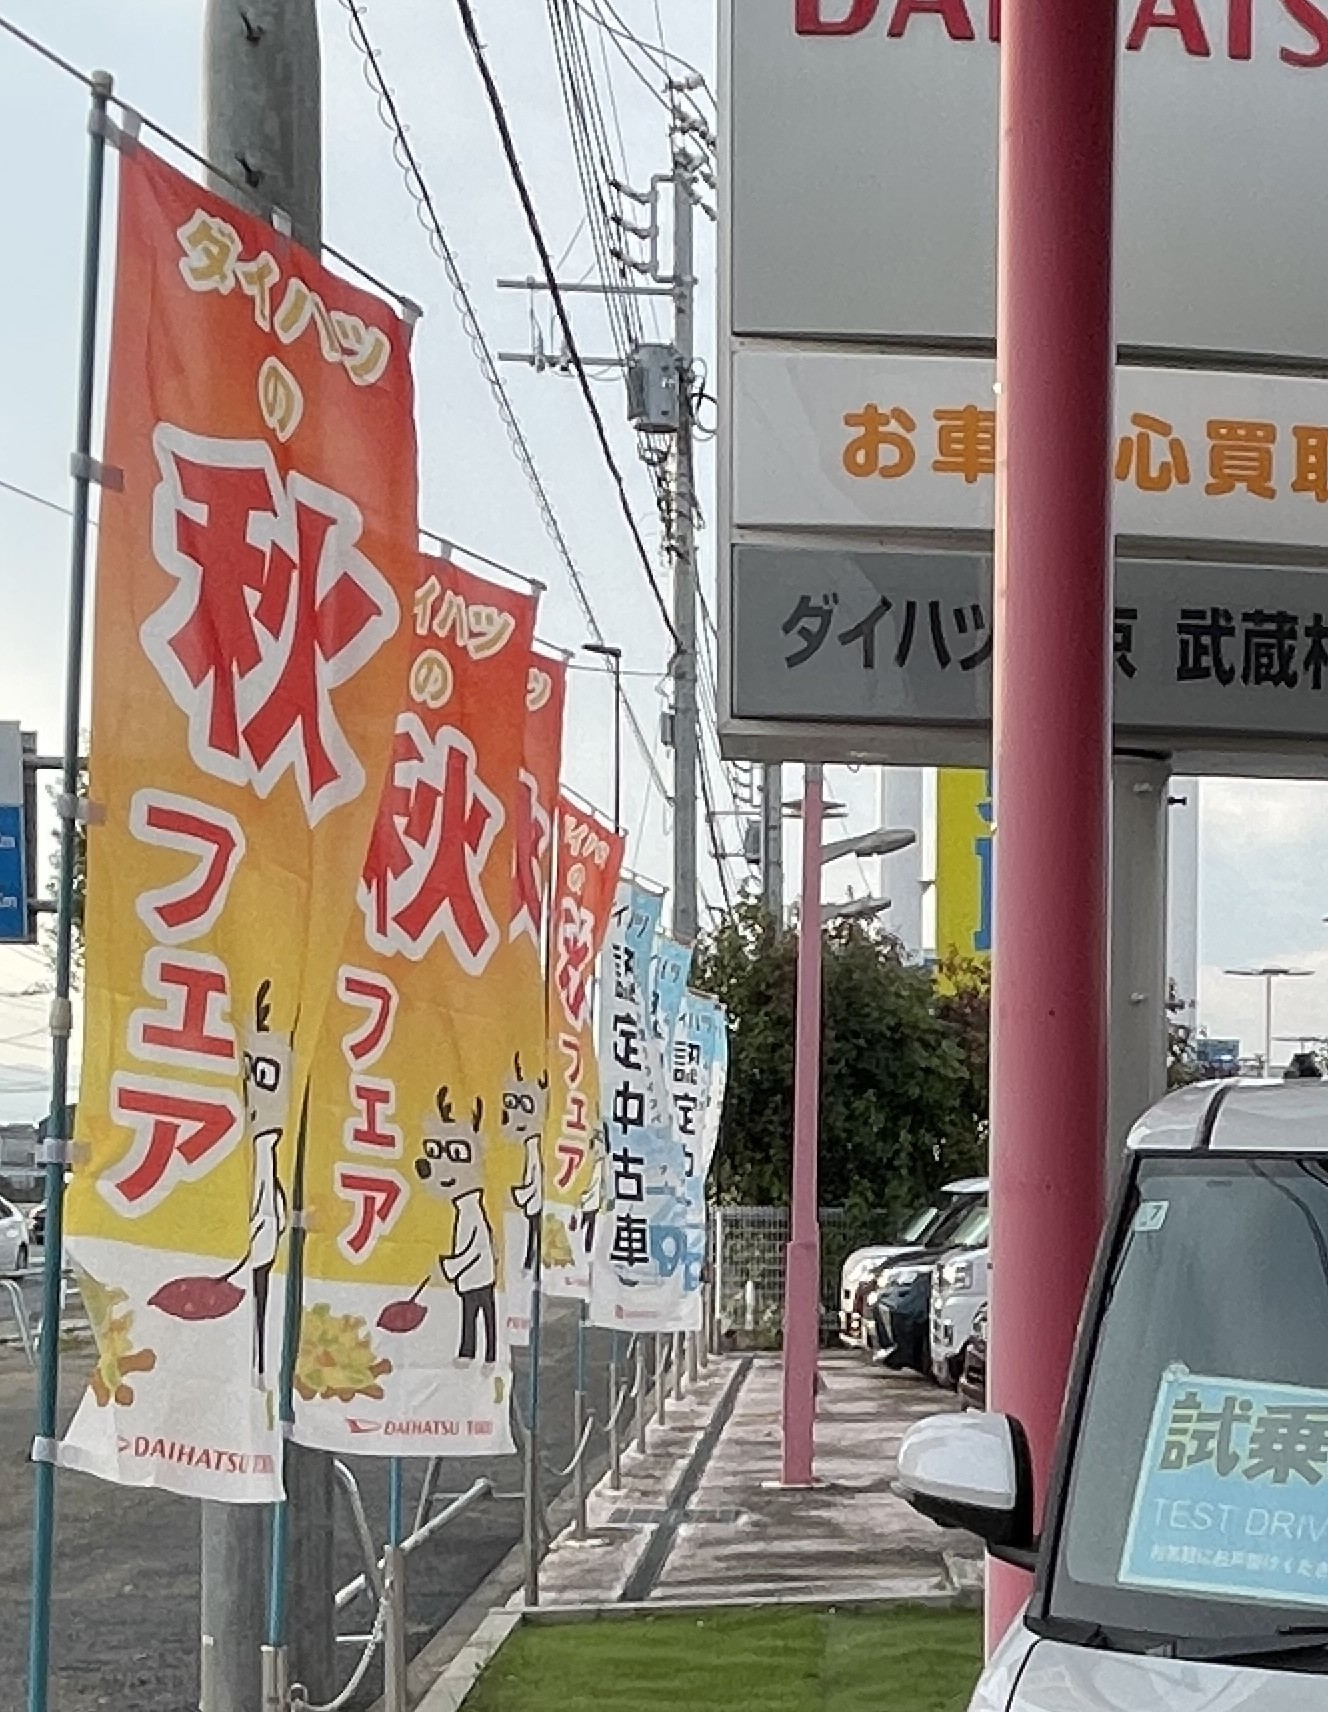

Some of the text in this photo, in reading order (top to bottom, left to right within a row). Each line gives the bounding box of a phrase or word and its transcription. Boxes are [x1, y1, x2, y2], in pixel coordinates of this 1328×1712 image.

[179, 211, 391, 385] ダイハツ
[259, 357, 303, 441] の
[339, 968, 401, 1263] フェア
[133, 1435, 249, 1475] DAIHATSU
[384, 1420, 460, 1436] DAIHATSU
[1153, 1499, 1238, 1534] TEST
